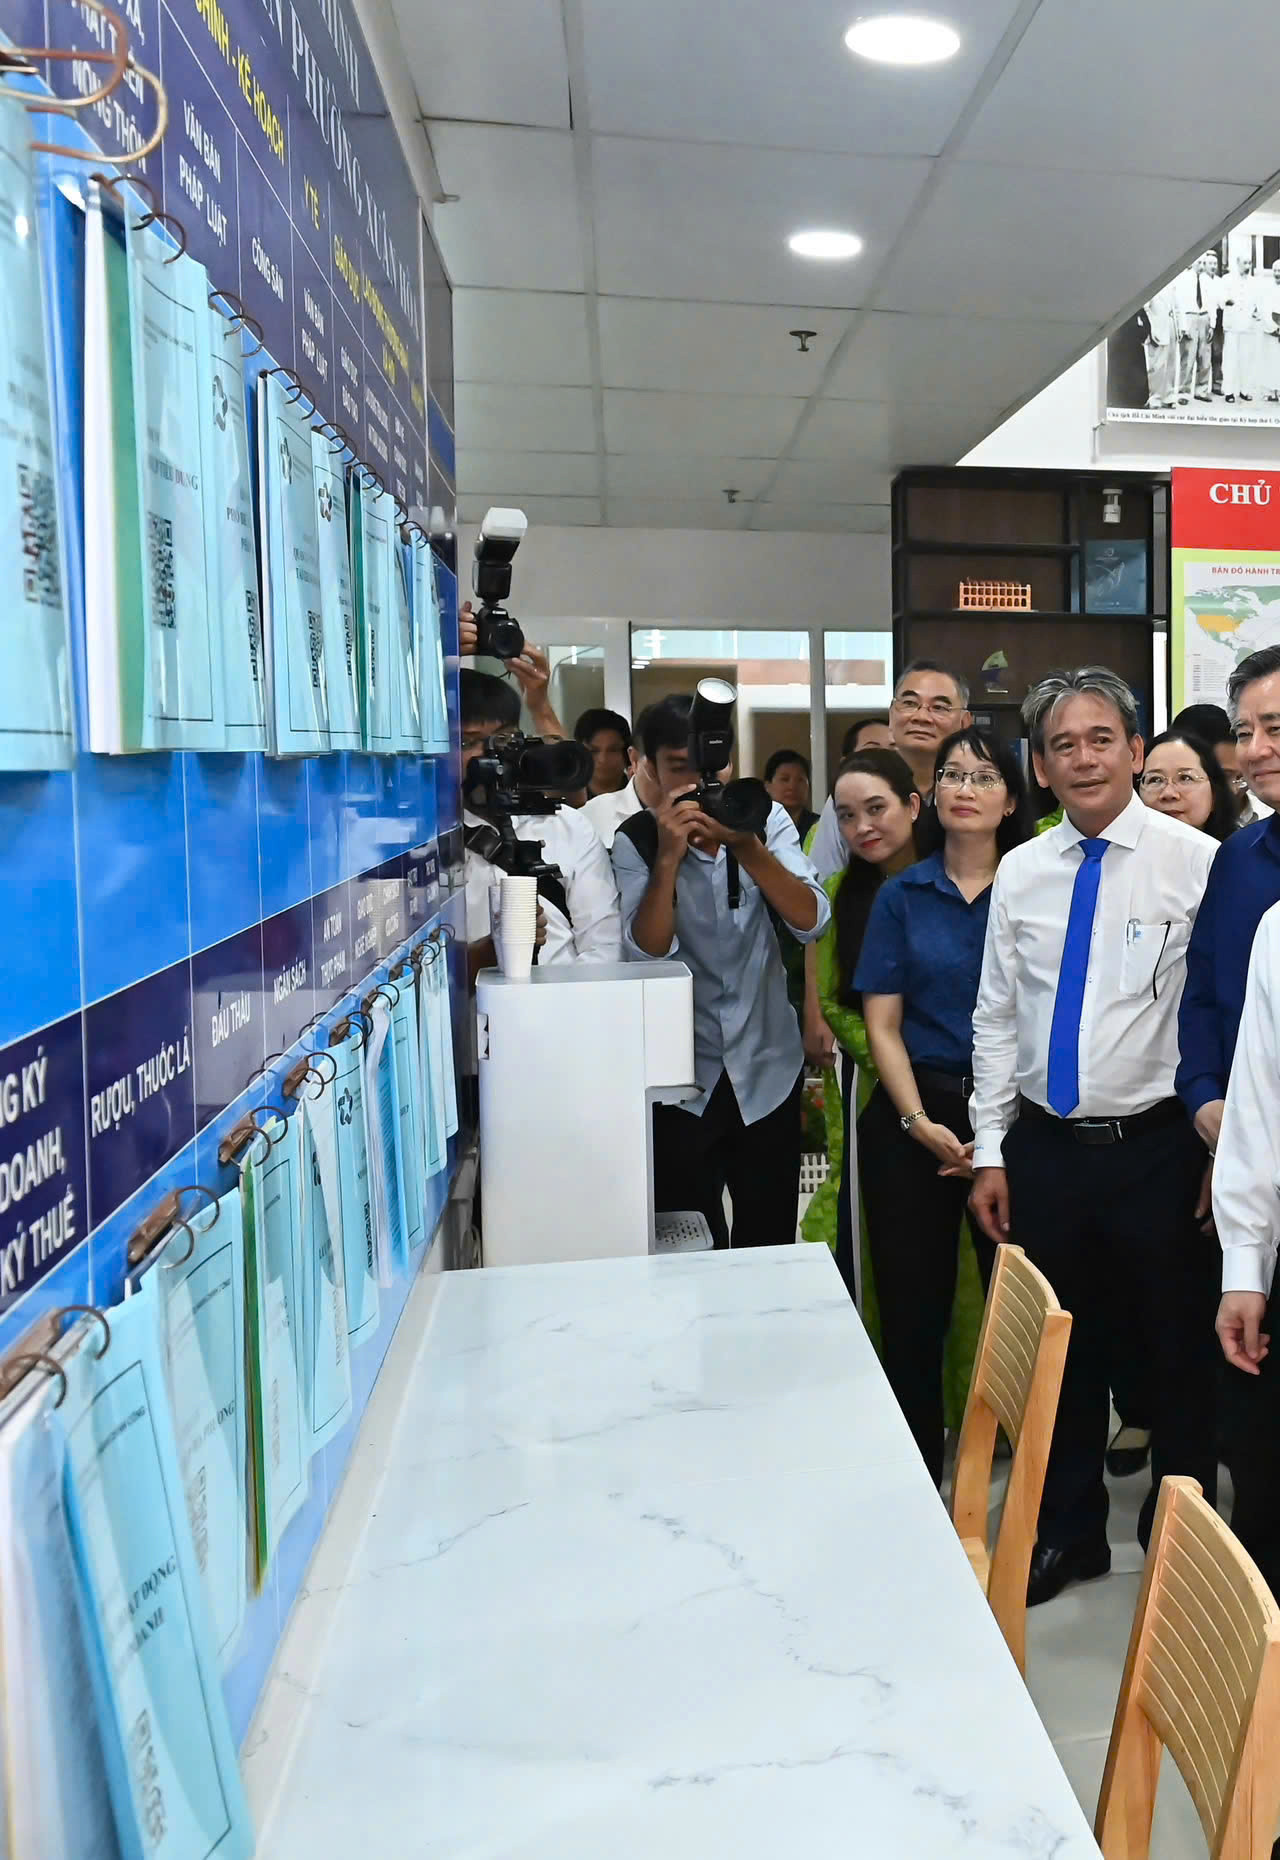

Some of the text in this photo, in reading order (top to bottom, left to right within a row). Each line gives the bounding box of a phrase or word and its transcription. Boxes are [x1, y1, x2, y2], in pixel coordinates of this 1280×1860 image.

[183, 99, 221, 183] VĂN BẢN
[251, 75, 284, 166] HOẠCH
[179, 154, 228, 247] PHÁP LUẬT
[252, 236, 271, 285] CÔNG
[1209, 479, 1271, 506] CHỦ
[1245, 566, 1269, 575] HÀNH
[273, 956, 306, 1006] NGÂN SÁCH
[22, 1045, 48, 1112] KÝ
[91, 1025, 191, 1138] RƯỢU, THUỐC LÁ
[29, 1183, 75, 1268] THUẾ
